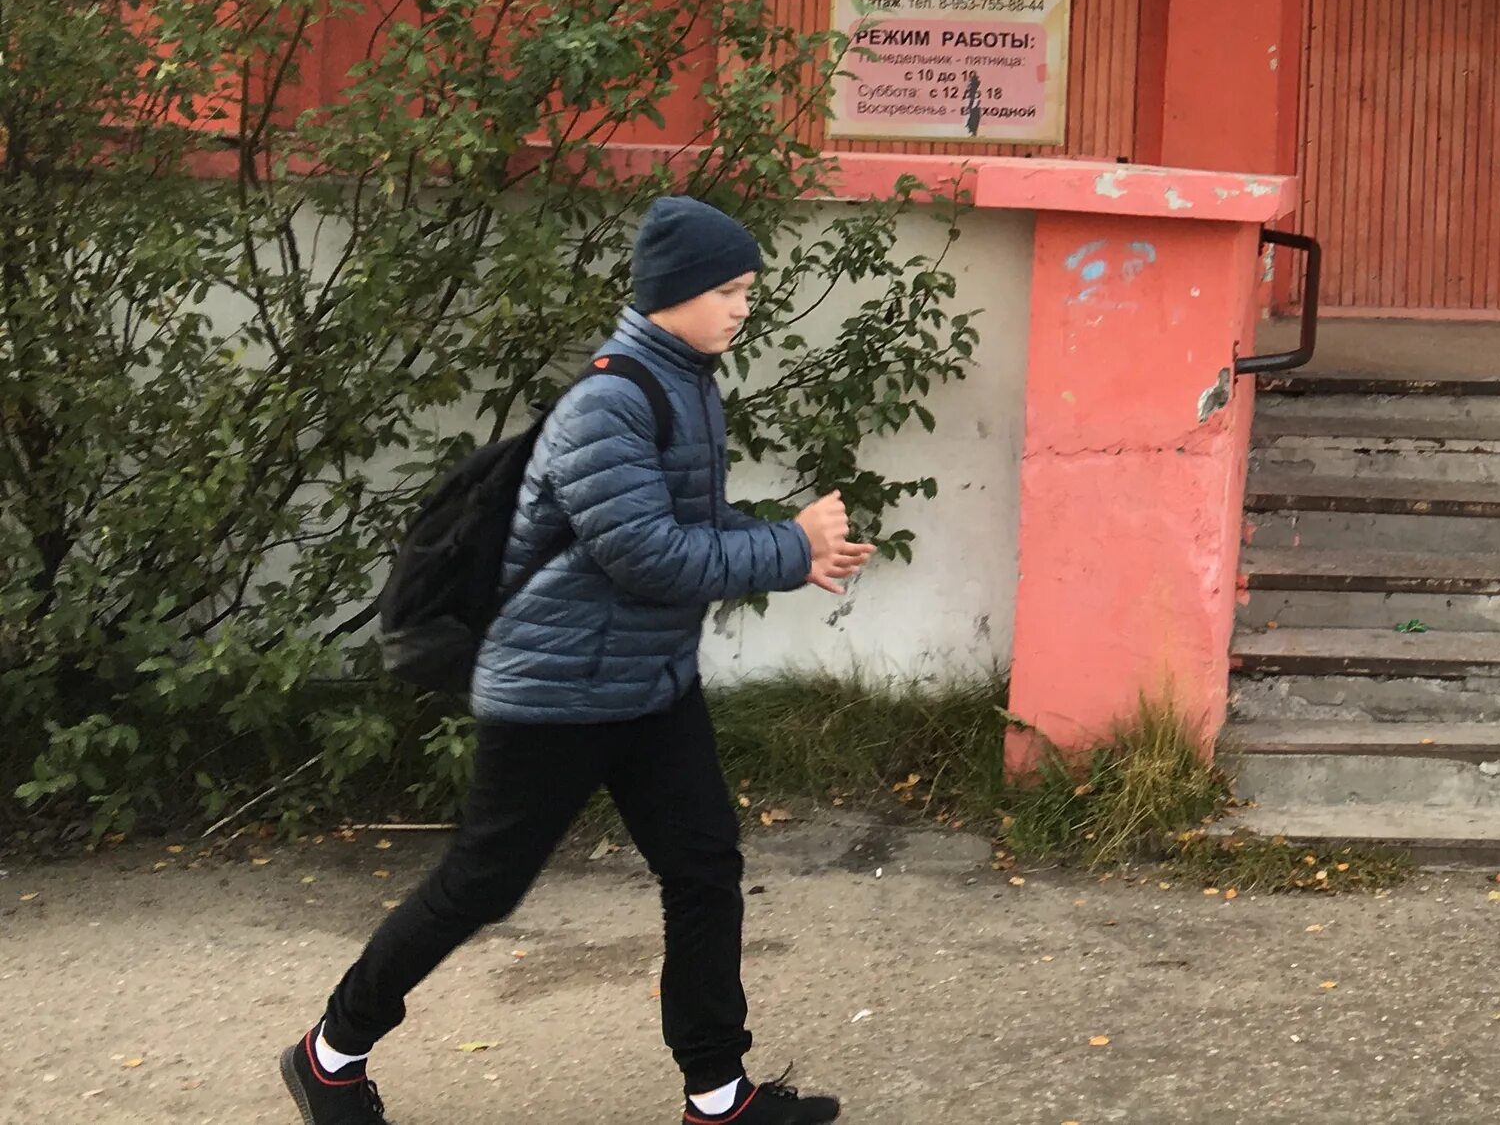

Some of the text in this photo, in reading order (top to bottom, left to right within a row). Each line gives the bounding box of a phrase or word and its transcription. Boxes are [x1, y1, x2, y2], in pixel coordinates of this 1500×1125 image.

[909, 0, 936, 10] тел.
[856, 29, 1036, 49] РЕЖИМ РАБОТЫ:
[903, 72, 913, 81] с
[918, 70, 934, 81] 10
[937, 72, 957, 84] до
[857, 84, 920, 100] Суббота:
[929, 89, 938, 98] с
[943, 87, 960, 99] 12
[986, 87, 1003, 100] 18
[857, 102, 947, 117] Воскресенье
[960, 105, 1036, 118] входной
